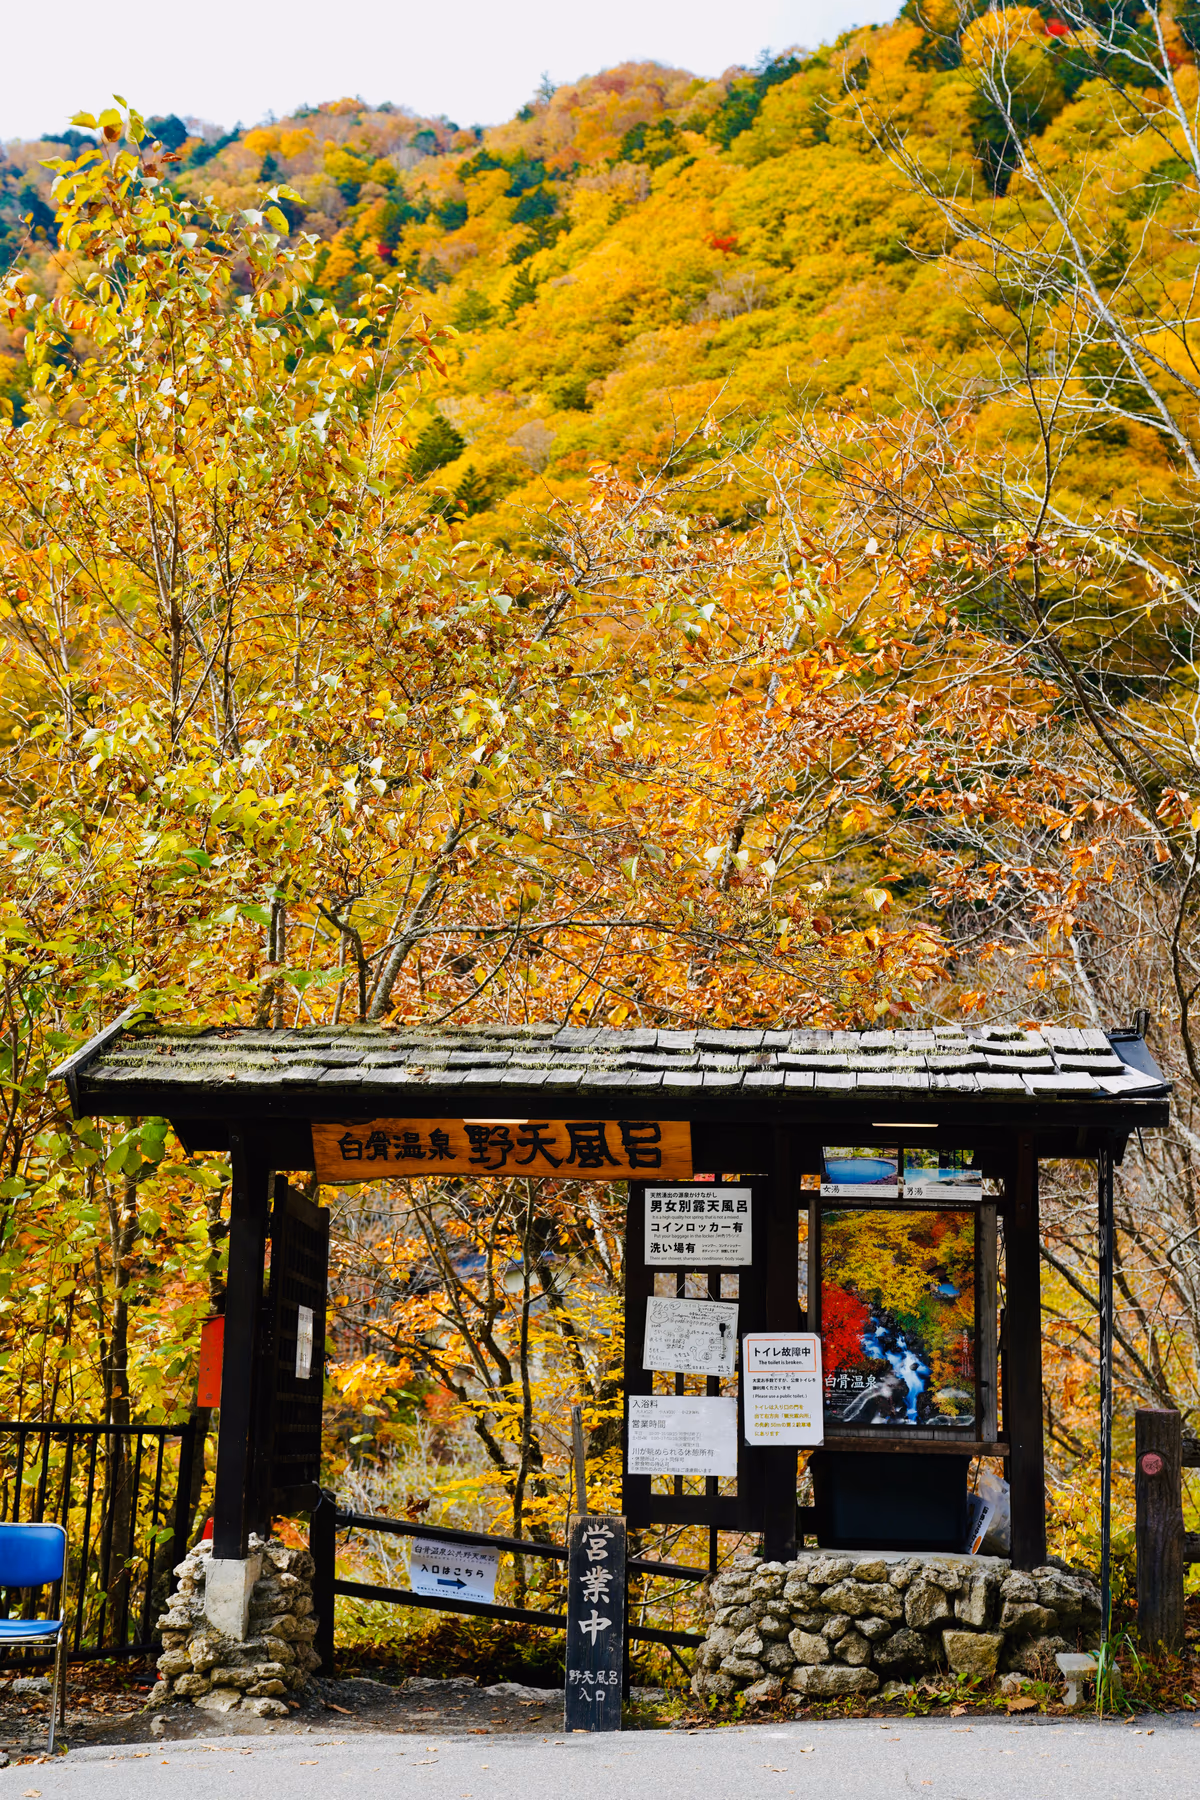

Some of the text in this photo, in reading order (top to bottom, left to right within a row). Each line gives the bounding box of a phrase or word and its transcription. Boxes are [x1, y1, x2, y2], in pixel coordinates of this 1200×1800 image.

[337, 1121, 663, 1170] 白骨温泉 野天風呂
[823, 1185, 840, 1194] 女湯
[906, 1187, 923, 1196] 男湯
[650, 1199, 748, 1213] 男女別露天風呂
[650, 1222, 743, 1233] コインロッカー有
[650, 1242, 696, 1254] 洗い場有
[755, 1347, 810, 1357] トイレ故障中
[824, 1374, 878, 1389] 白骨温泉
[632, 1400, 658, 1408] 入浴料
[632, 1420, 666, 1428] 営業時間
[632, 1448, 714, 1456] 川が眺められる休憩所有
[421, 1564, 484, 1578] 入口はこちら
[578, 1524, 615, 1647] 営業中
[569, 1669, 618, 1685] 野天風呂
[578, 1688, 606, 1702] 入口
